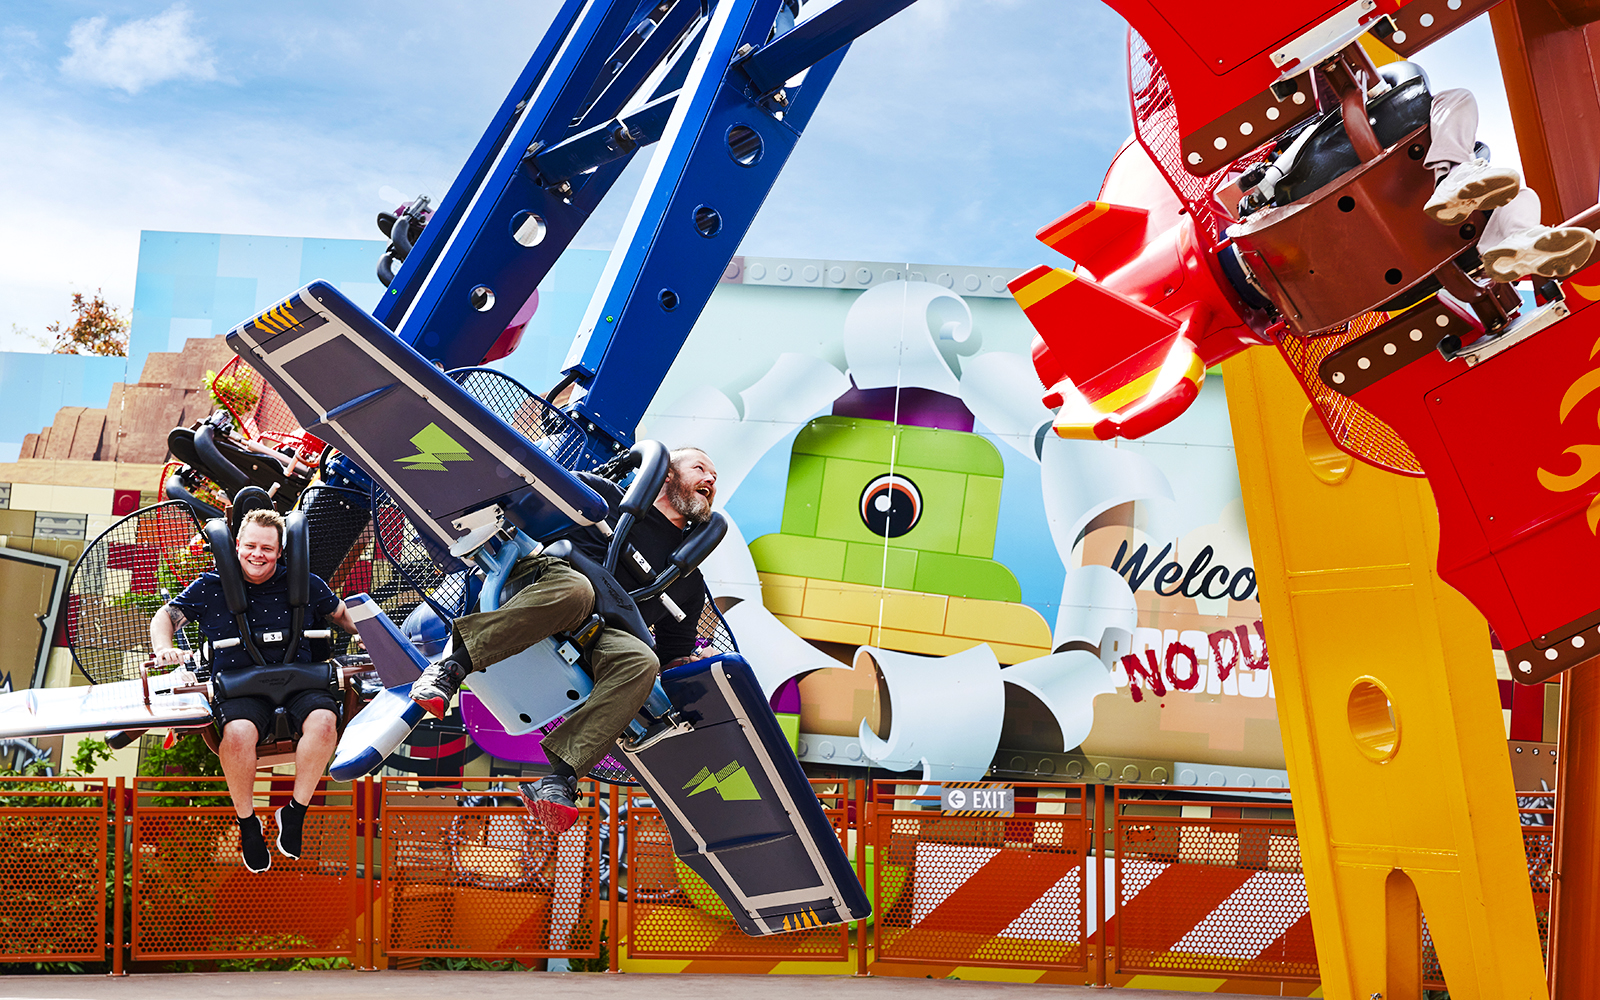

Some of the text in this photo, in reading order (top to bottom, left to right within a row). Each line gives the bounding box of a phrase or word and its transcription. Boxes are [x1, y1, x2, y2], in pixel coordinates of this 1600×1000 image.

[639, 558, 645, 566] 2
[1111, 540, 1261, 603] Welco
[270, 633, 276, 641] 3
[1100, 626, 1276, 699] BRICKS
[1121, 641, 1200, 703] NO
[973, 790, 1007, 809] EXIT
